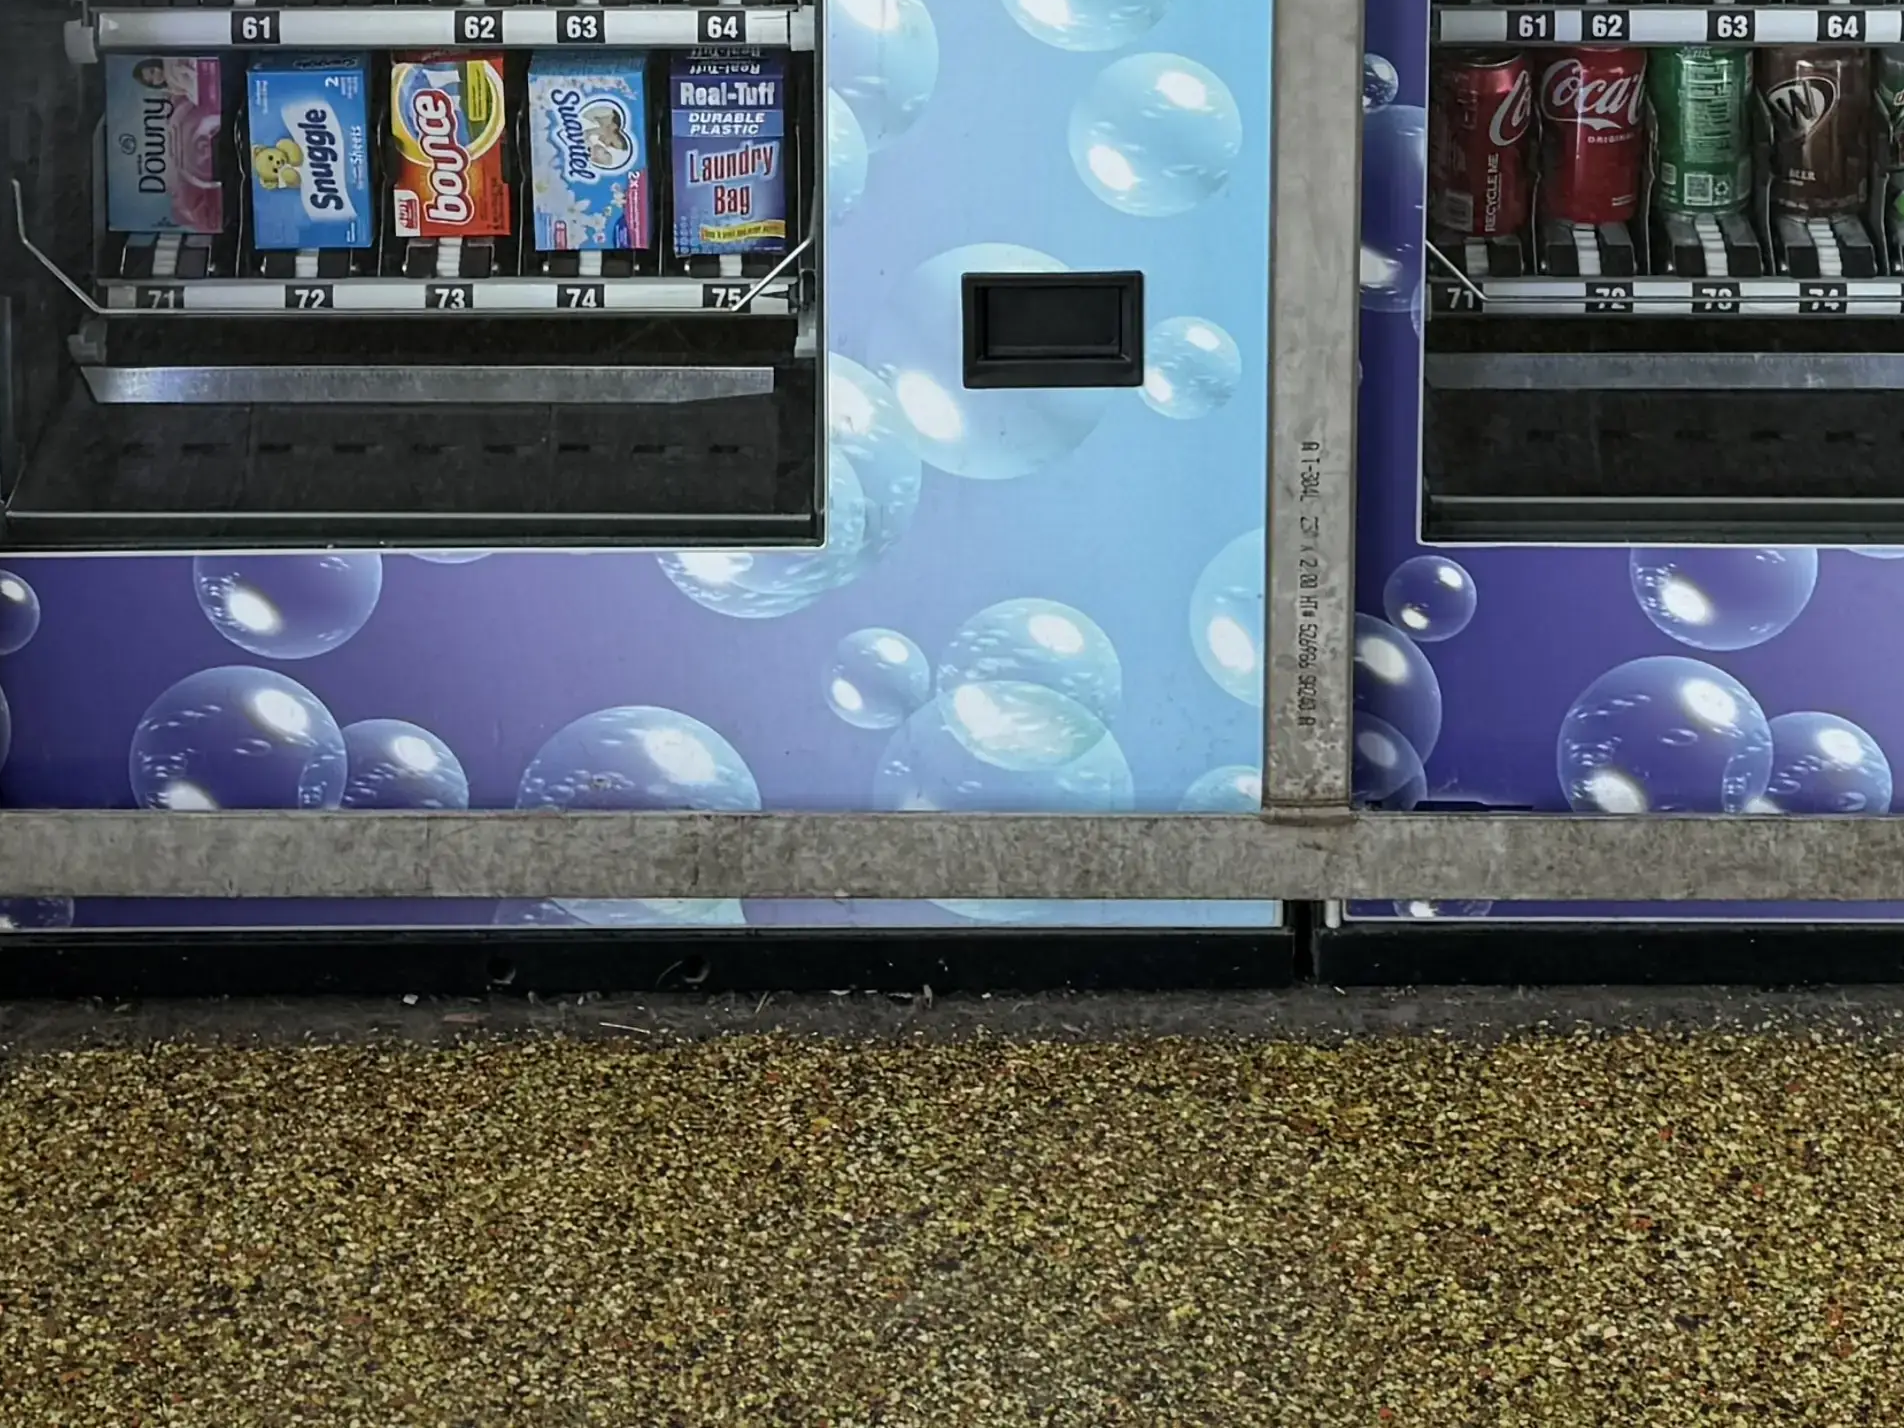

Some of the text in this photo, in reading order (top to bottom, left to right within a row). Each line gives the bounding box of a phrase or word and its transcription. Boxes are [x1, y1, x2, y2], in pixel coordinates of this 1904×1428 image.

[242, 15, 739, 39] 61 62 63 64
[1519, 14, 1547, 38] 61
[1592, 14, 1623, 37] 62
[1717, 14, 1748, 38] 63
[1827, 15, 1859, 38] 64
[680, 81, 776, 107] Real-Tuff
[550, 87, 597, 182] Suavitel
[688, 112, 766, 124] DURABLE
[689, 123, 760, 136] PLASTIC
[138, 97, 174, 194] Downy
[297, 107, 344, 212] Snuggle
[414, 94, 469, 223] bounce
[689, 140, 775, 184] Laundry
[714, 184, 751, 217] Bag
[1484, 152, 1500, 233] RECYCLE ME
[296, 290, 596, 308] 72 73 74
